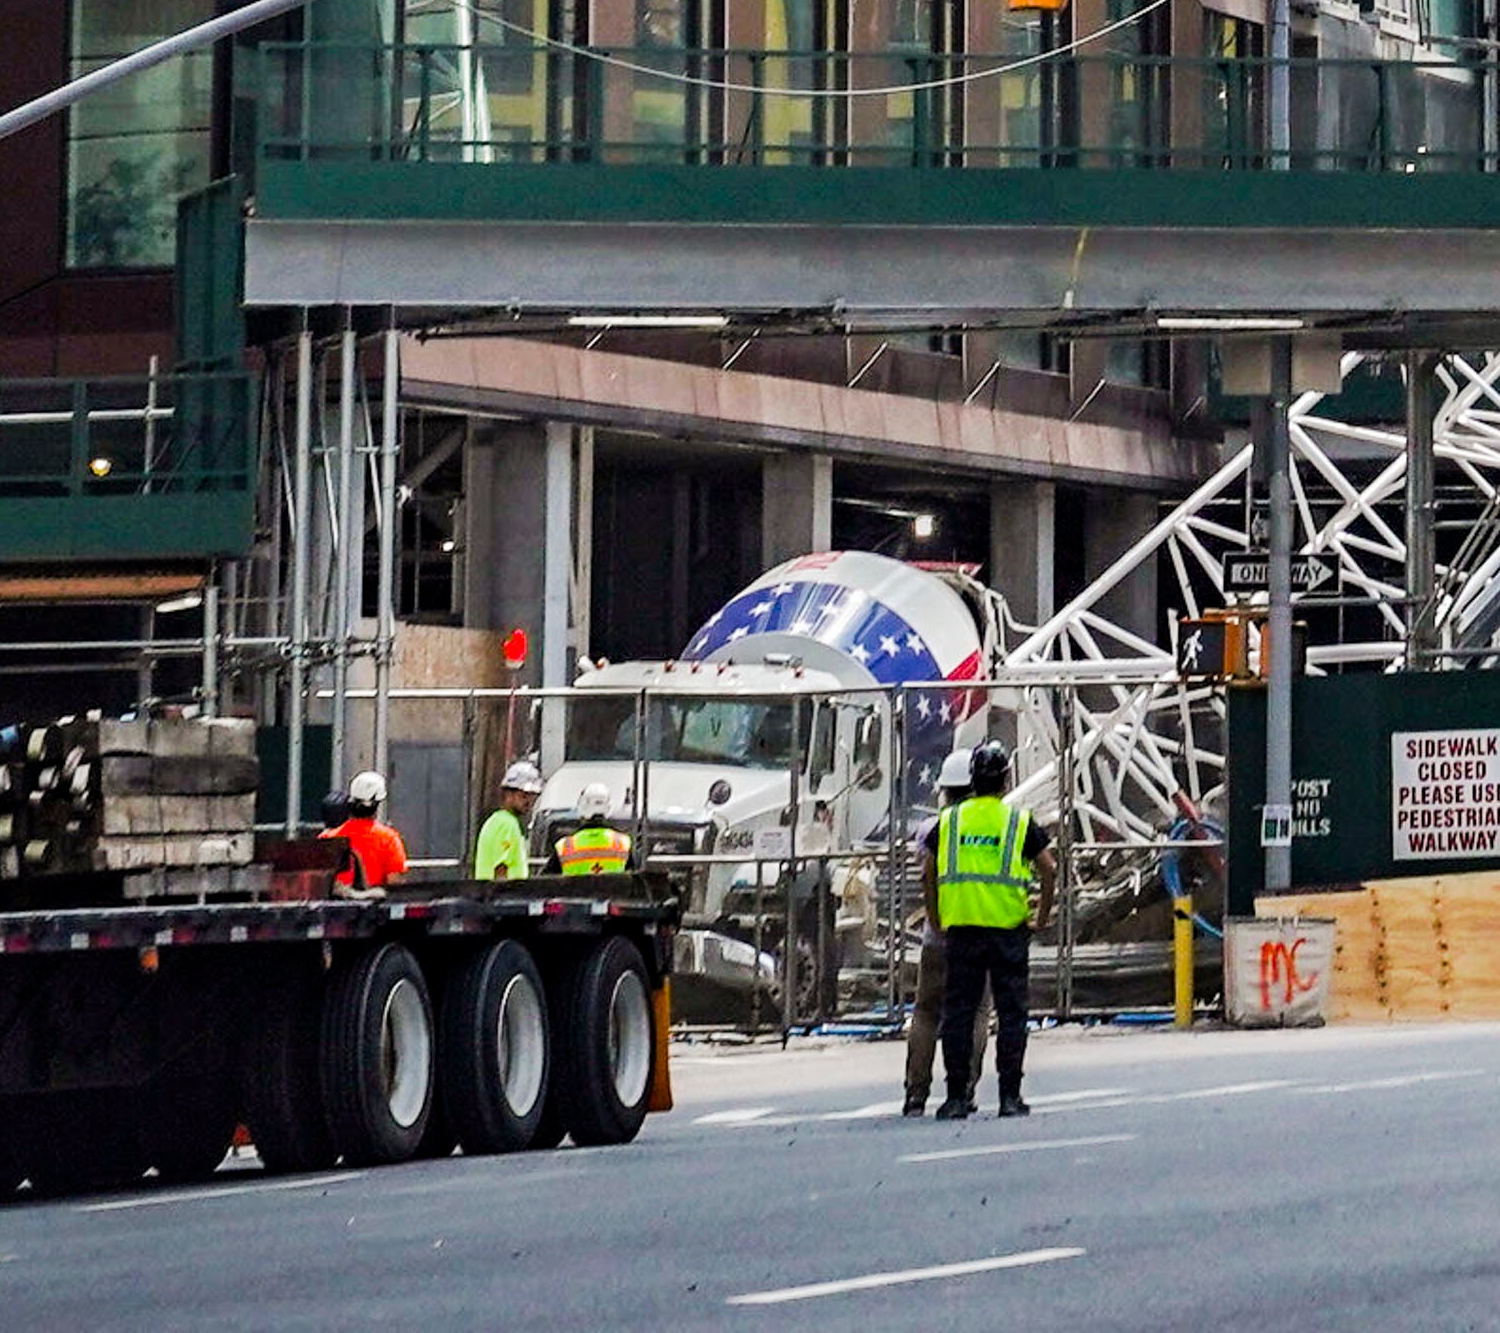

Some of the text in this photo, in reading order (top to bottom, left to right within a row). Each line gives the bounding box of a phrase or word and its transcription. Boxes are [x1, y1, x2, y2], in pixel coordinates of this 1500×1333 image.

[1406, 736, 1498, 760] SIDEWALK
[1418, 760, 1488, 782] CLOSED
[1399, 785, 1465, 806] PLEASE
[1297, 799, 1320, 817] NO
[1408, 830, 1497, 853] WALKWAY
[1259, 936, 1320, 1012] MC
